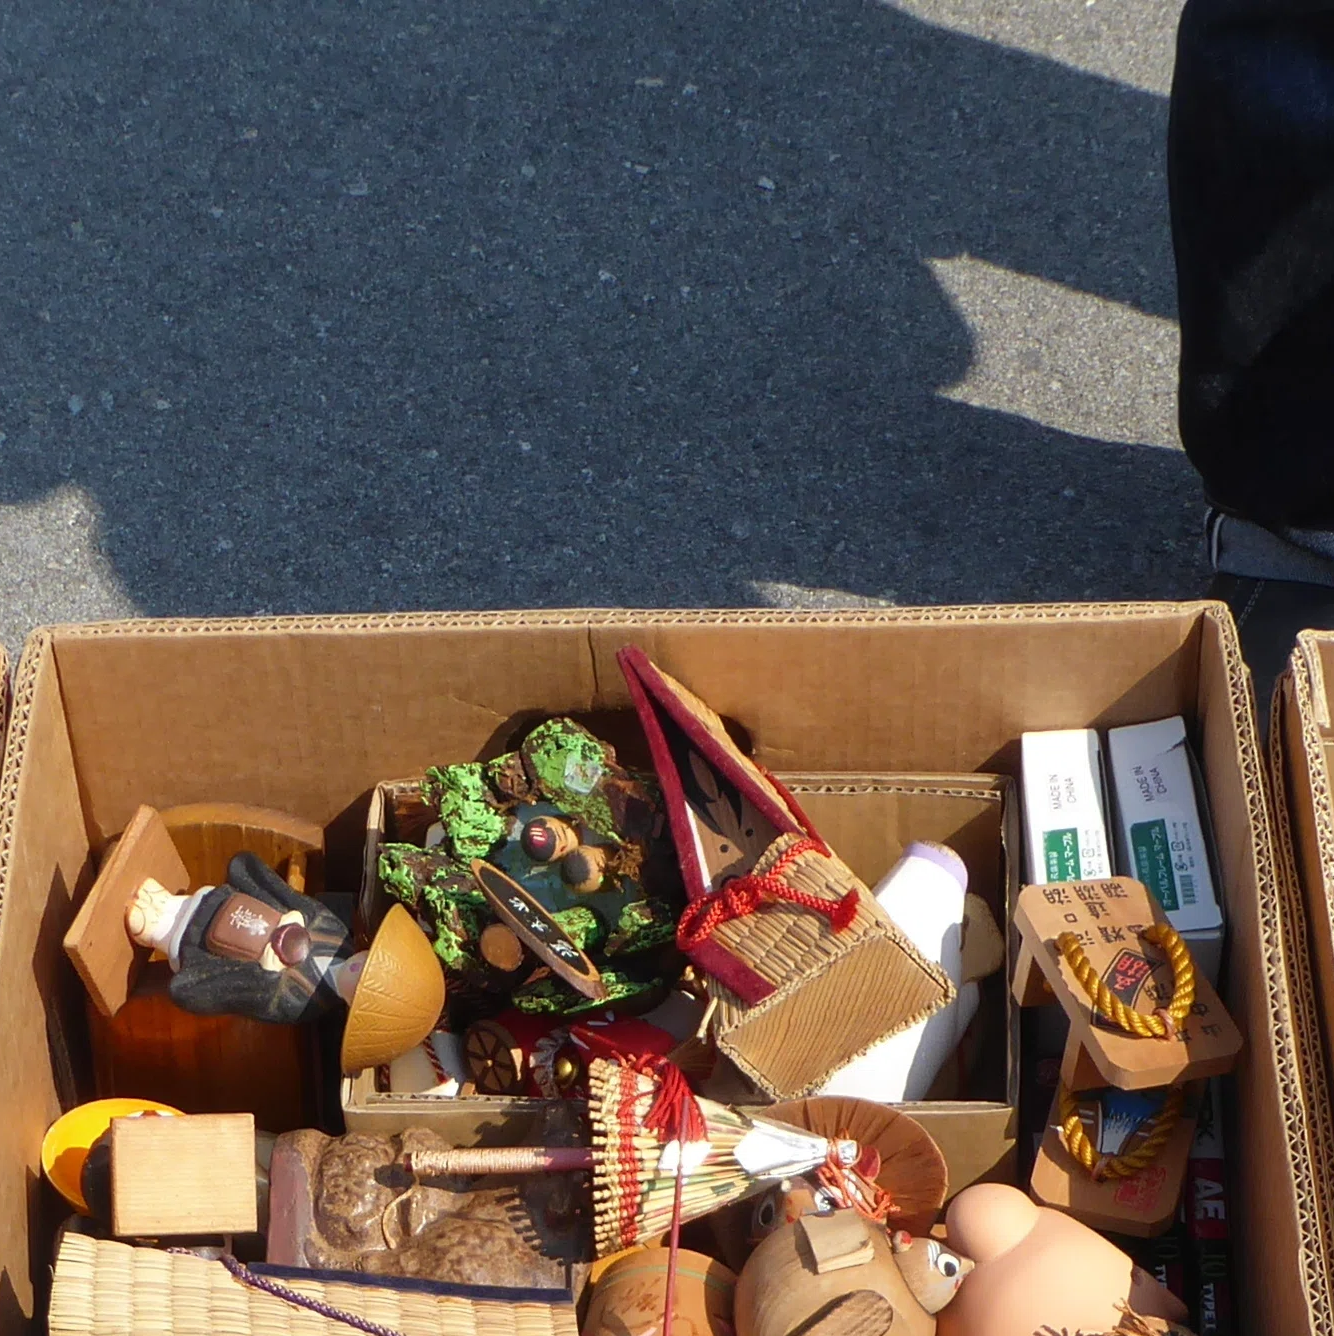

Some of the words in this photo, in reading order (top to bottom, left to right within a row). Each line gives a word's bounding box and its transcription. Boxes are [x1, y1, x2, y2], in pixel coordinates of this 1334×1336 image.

[1048, 774, 1058, 783] IN
[1132, 765, 1144, 776] IN
[1150, 766, 1168, 795] CHINA
[1050, 784, 1061, 810] MADE
[1064, 777, 1077, 803] CHINA
[1135, 776, 1155, 803] MADE
[1195, 1176, 1226, 1221] AE
[1203, 1282, 1215, 1320] TYPE
